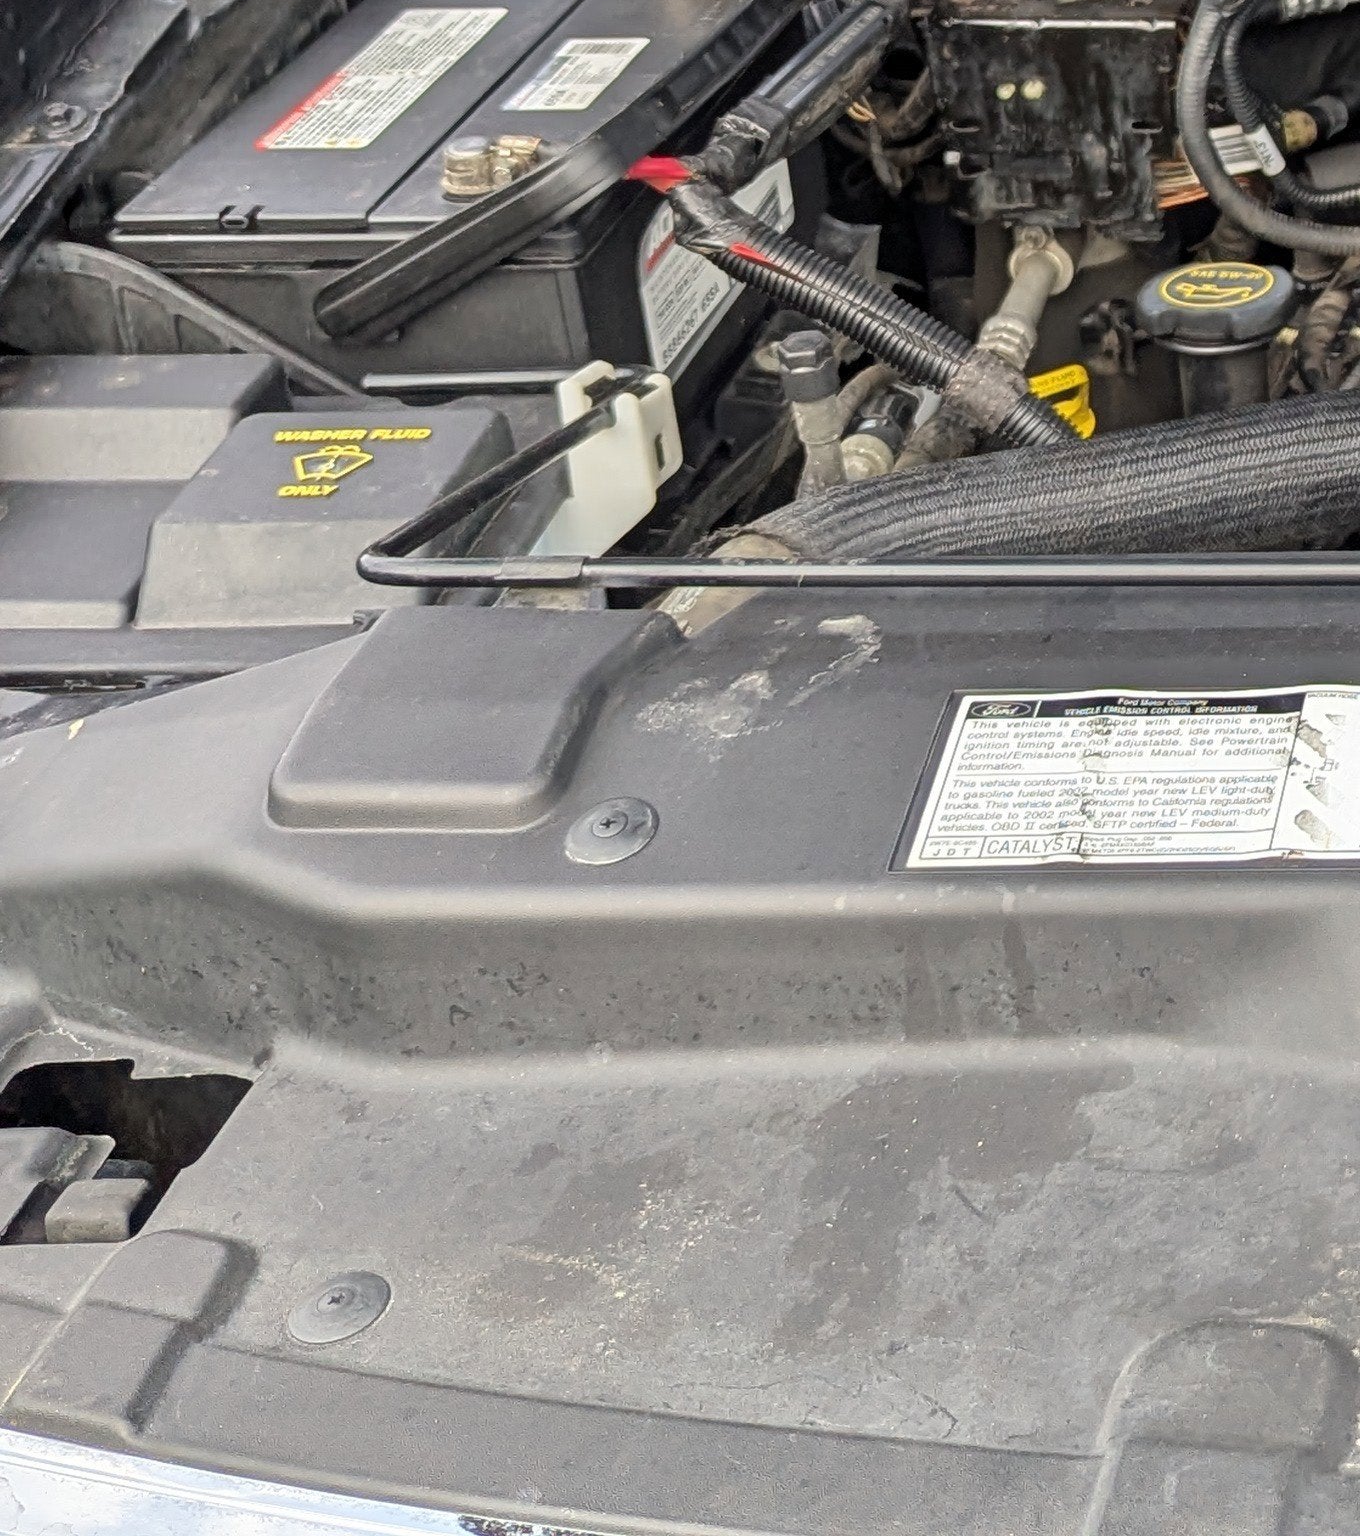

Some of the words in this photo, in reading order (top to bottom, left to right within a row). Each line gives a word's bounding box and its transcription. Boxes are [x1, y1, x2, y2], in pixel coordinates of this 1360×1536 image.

[274, 428, 367, 443] WASHER
[369, 428, 431, 441] FLUID
[277, 484, 339, 498] ONLY
[982, 703, 1020, 716] Ford
[1118, 698, 1139, 706] Ford
[972, 721, 998, 729] This
[1007, 721, 1051, 729] vehicle
[1058, 720, 1069, 728] is
[1179, 717, 1241, 725] electronic
[1250, 716, 1292, 725] engine
[967, 731, 1009, 739] control
[1071, 728, 1112, 738] Engine
[1117, 728, 1138, 736] idle
[1189, 726, 1211, 735] idle
[1215, 726, 1262, 735] mixture,
[1268, 725, 1290, 733] and
[1017, 740, 1055, 750] timing
[1085, 738, 1109, 747] not
[1115, 738, 1181, 747] adjustable.
[1190, 737, 1214, 746] See
[1221, 736, 1288, 745] Powertrain
[961, 751, 1076, 760] Control/Emissions
[1151, 748, 1196, 757] Manual
[1201, 748, 1219, 756] for
[1225, 747, 1286, 756] additional
[957, 762, 1025, 771] information.
[953, 779, 976, 788] This
[981, 779, 1020, 787] vehicle
[1023, 778, 1077, 787] conforms
[1081, 775, 1092, 784] to
[1096, 774, 1118, 785] U.S.
[1124, 776, 1147, 785] EPA
[1152, 776, 1215, 785] regulations
[1219, 775, 1278, 784] applicable
[948, 791, 957, 799] to
[963, 791, 1014, 801] gasoline
[1018, 789, 1057, 798] fueled
[1092, 787, 1129, 796] model
[1133, 787, 1159, 796] year
[1163, 787, 1187, 795] new
[1192, 786, 1217, 794] LEV
[1221, 784, 1276, 795] light-duty
[945, 801, 981, 810] trucks.
[986, 801, 1010, 809] This
[1013, 800, 1052, 809] vehicle
[1055, 798, 1078, 808] also
[1138, 798, 1149, 806] to
[1153, 797, 1206, 806] California
[1210, 794, 1272, 806] regulations
[940, 811, 1002, 822] applicable
[1008, 811, 1019, 819] to
[1024, 810, 1054, 819] 2002
[1101, 810, 1126, 819] year
[1161, 808, 1187, 817] LEV
[1192, 807, 1271, 817] medium-duty
[938, 823, 987, 832] vehicles.
[991, 822, 1020, 831] OBD
[1093, 820, 1127, 829] SFTP
[1130, 820, 1177, 828] certified
[1191, 818, 1239, 828] Federal.
[986, 836, 1076, 854] CATALYST
